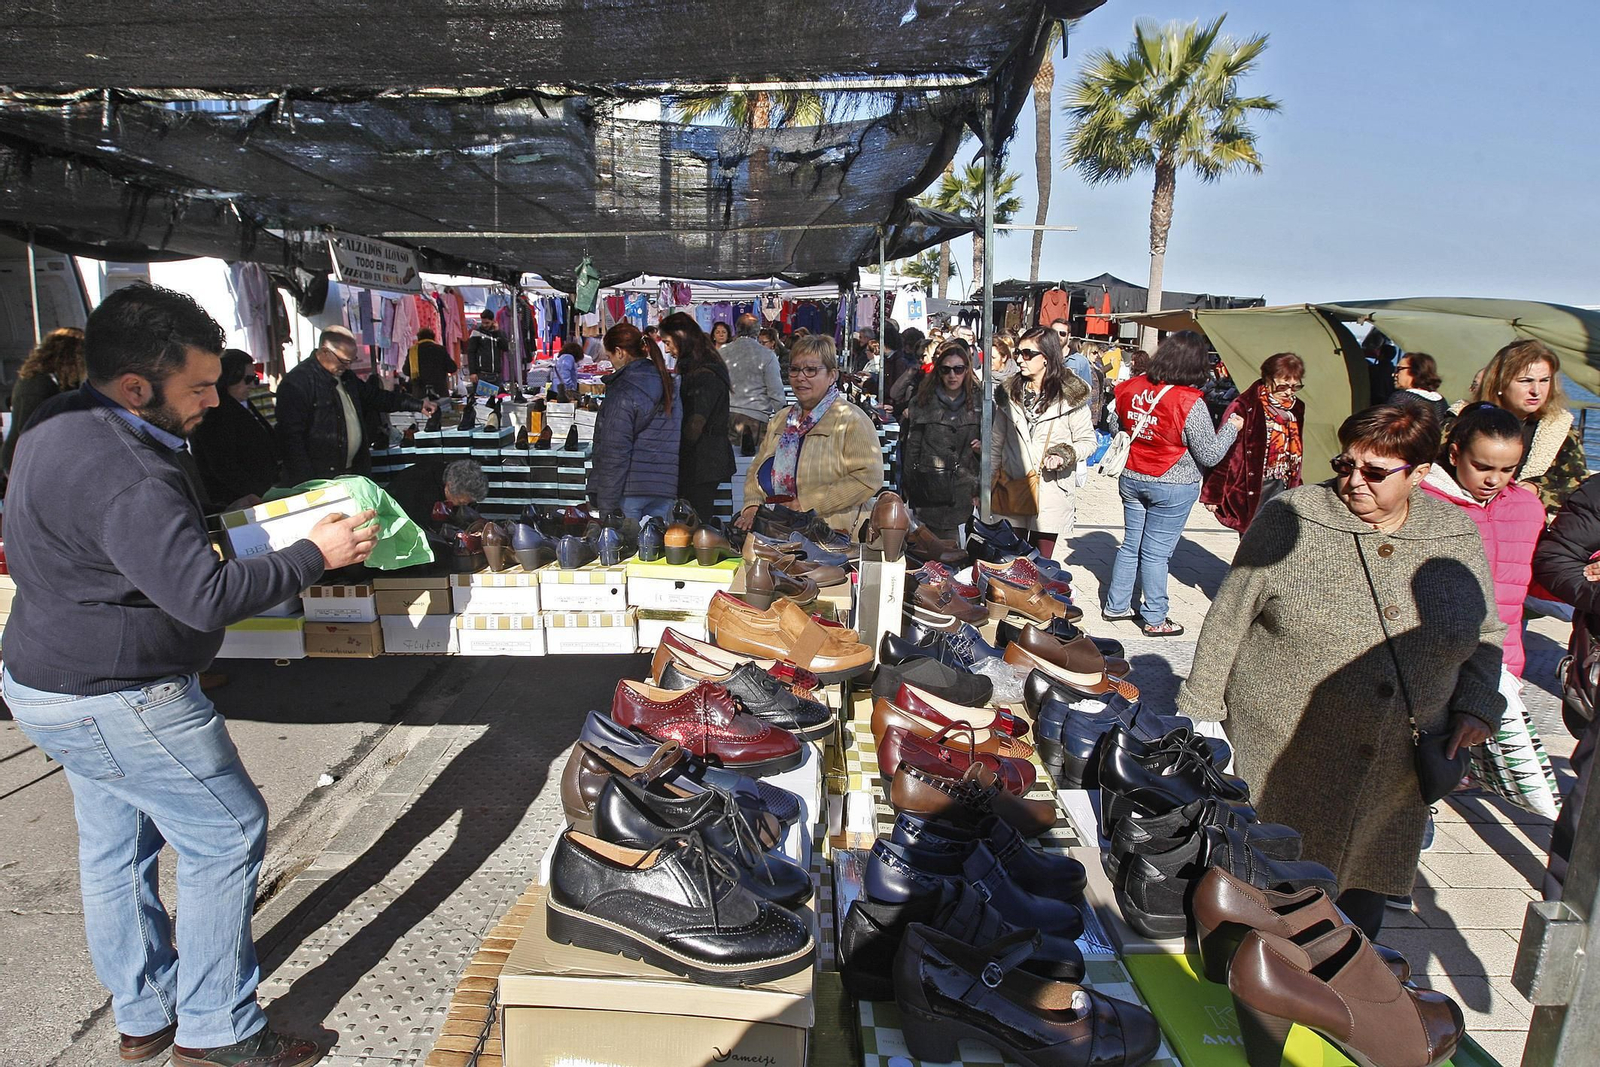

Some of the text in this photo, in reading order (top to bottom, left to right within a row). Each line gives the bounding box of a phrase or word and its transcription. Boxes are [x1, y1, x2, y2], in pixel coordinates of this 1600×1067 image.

[339, 237, 409, 263] CALZADOS ALONSO
[344, 266, 373, 280] HECHO
[373, 272, 382, 282] EN
[355, 256, 398, 274] TODO EN PIEL
[1127, 410, 1158, 425] REMAR
[712, 1046, 776, 1067] Yameiji
